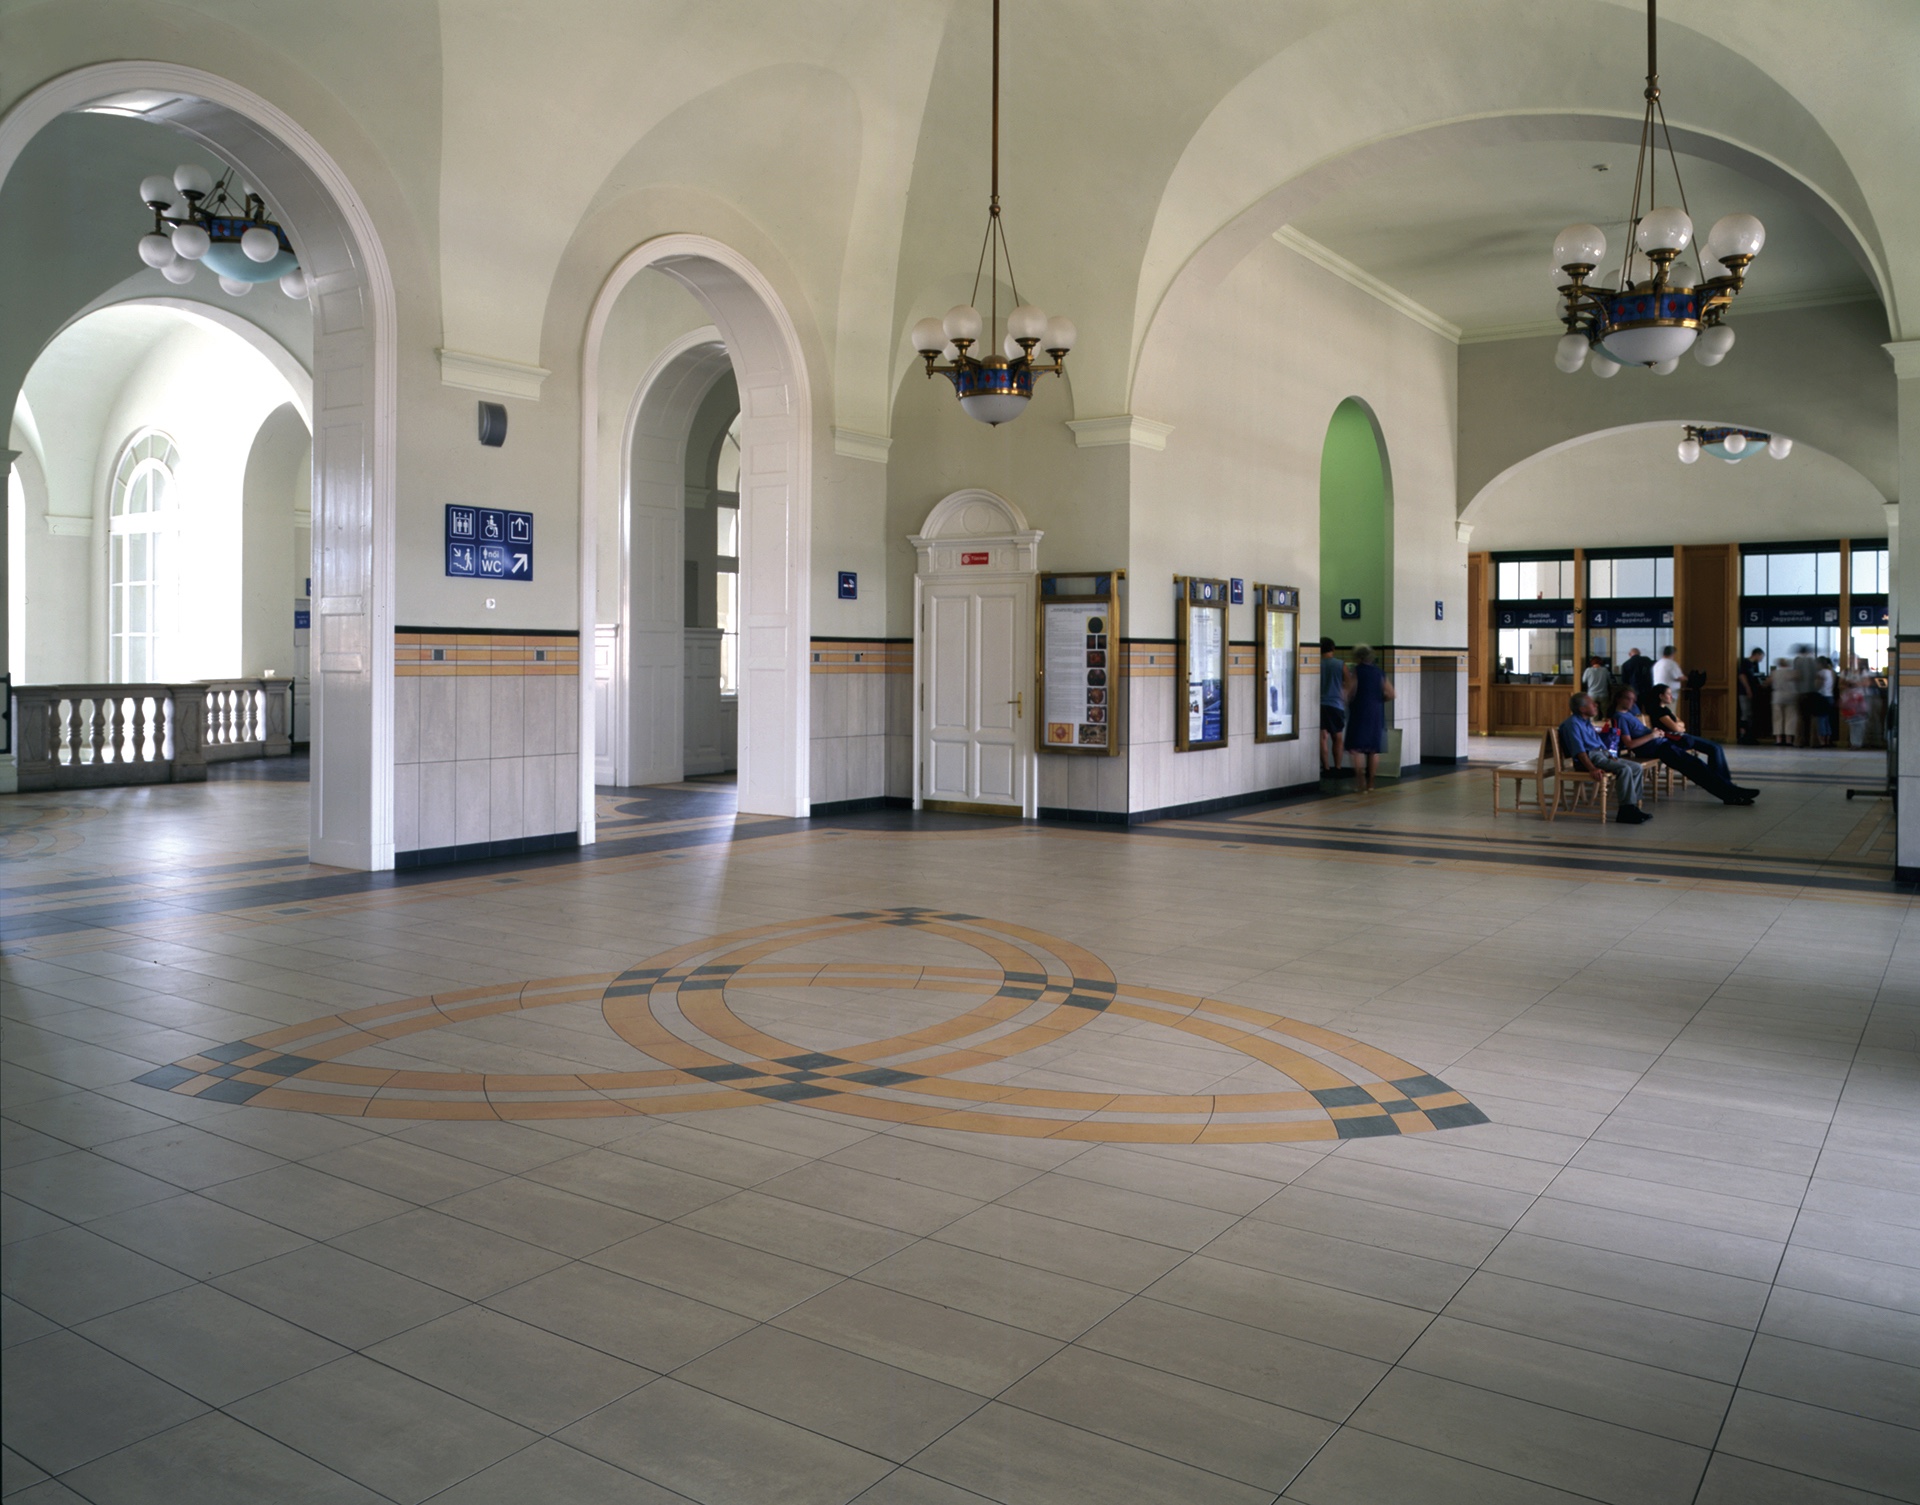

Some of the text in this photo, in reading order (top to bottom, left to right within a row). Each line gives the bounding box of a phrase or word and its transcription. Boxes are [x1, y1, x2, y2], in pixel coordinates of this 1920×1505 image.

[481, 560, 501, 572] WC
[1504, 614, 1511, 624] 3
[1594, 613, 1602, 623] 4
[1750, 612, 1758, 622] 5
[1858, 610, 1868, 620] 6
